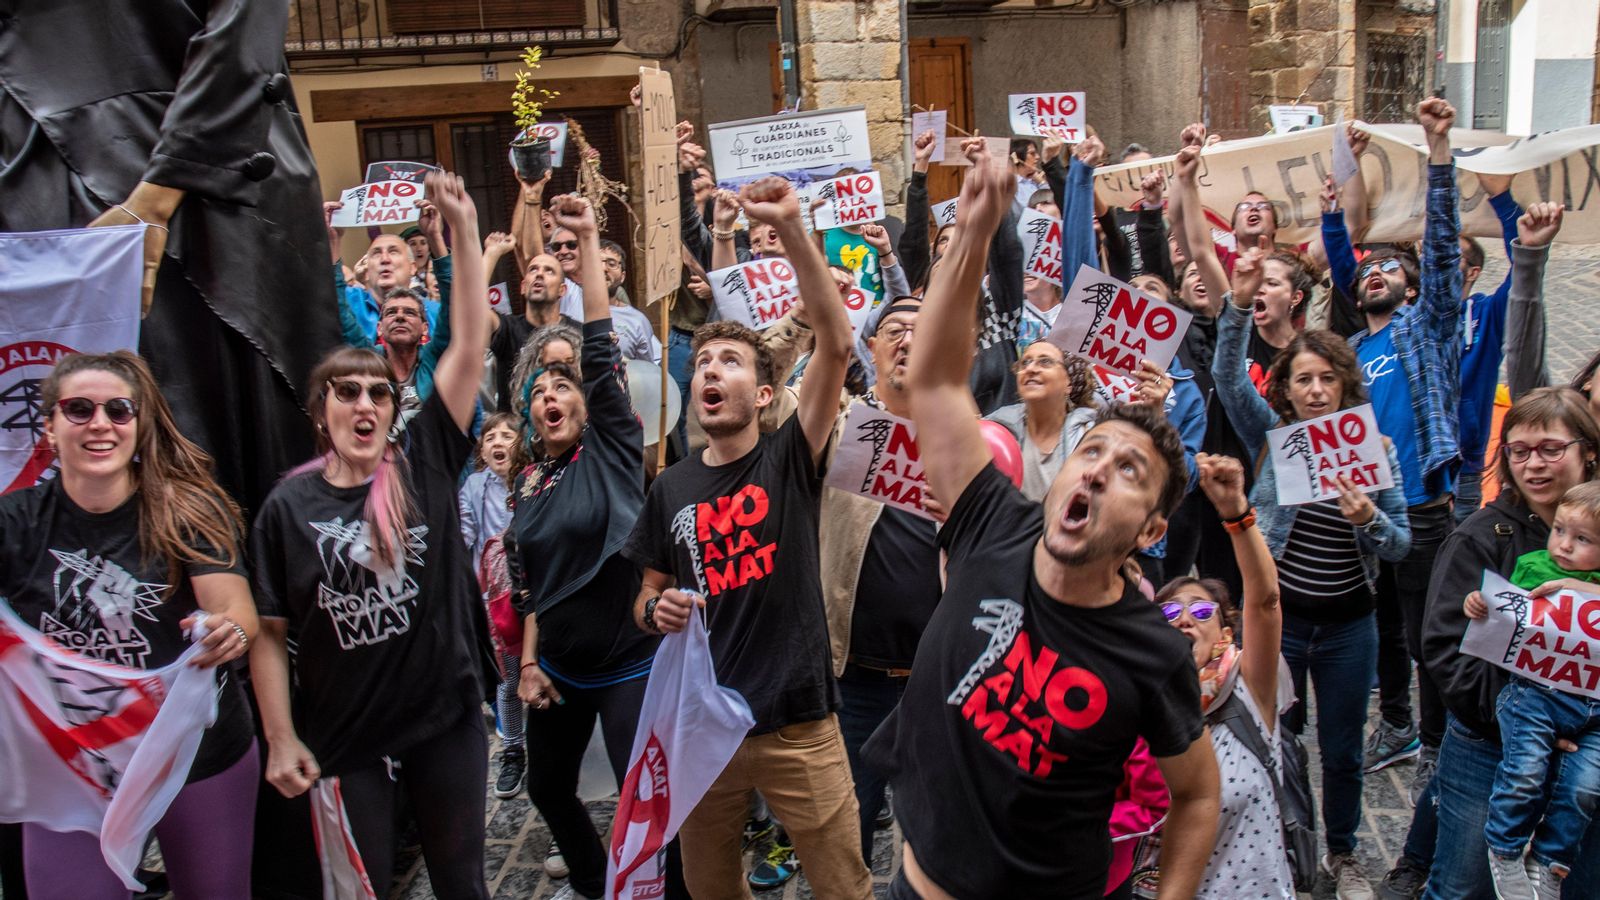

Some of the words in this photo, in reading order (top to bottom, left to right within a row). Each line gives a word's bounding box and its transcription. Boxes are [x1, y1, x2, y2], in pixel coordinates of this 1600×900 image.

[486, 65, 494, 77] 4
[1036, 95, 1077, 116] NO
[753, 127, 828, 144] GUARDIANES
[768, 121, 801, 132] XARXA
[1038, 118, 1047, 127] A
[1050, 117, 1067, 127] LA
[751, 144, 834, 162] TRADICIONALS
[367, 182, 417, 198] NO
[834, 175, 874, 199] NO
[363, 207, 413, 223] MAT
[367, 199, 377, 208] A
[381, 198, 401, 208] LA
[840, 199, 848, 208] A
[850, 196, 867, 206] LA
[840, 205, 878, 224] MAT
[1045, 221, 1062, 249] N
[1040, 246, 1051, 258] A
[1054, 250, 1062, 262] L
[743, 260, 794, 290] NO
[1033, 257, 1062, 283] MA
[754, 291, 766, 305] A
[769, 284, 791, 300] LA
[757, 296, 798, 324] MA
[1107, 288, 1177, 341] NO
[1099, 323, 1116, 341] A
[1119, 330, 1147, 355] LA
[1088, 337, 1142, 374] MA
[1112, 385, 1125, 399] A
[1123, 378, 1138, 390] L
[886, 422, 921, 463] N
[1306, 412, 1367, 455] NO
[880, 458, 897, 475] A
[1318, 456, 1333, 472] A
[1335, 449, 1363, 467] LA
[871, 474, 925, 510] MA
[696, 483, 769, 543] NO
[703, 542, 725, 564] A
[725, 529, 760, 557] LA
[704, 542, 778, 597] MAT
[329, 604, 410, 650] MA
[1524, 631, 1548, 651] A
[1553, 635, 1591, 660] LA
[1003, 629, 1108, 731] NO
[1515, 648, 1600, 691] MAT
[982, 670, 1015, 706] A
[1010, 692, 1054, 745] LA
[961, 684, 1069, 778] MAT
